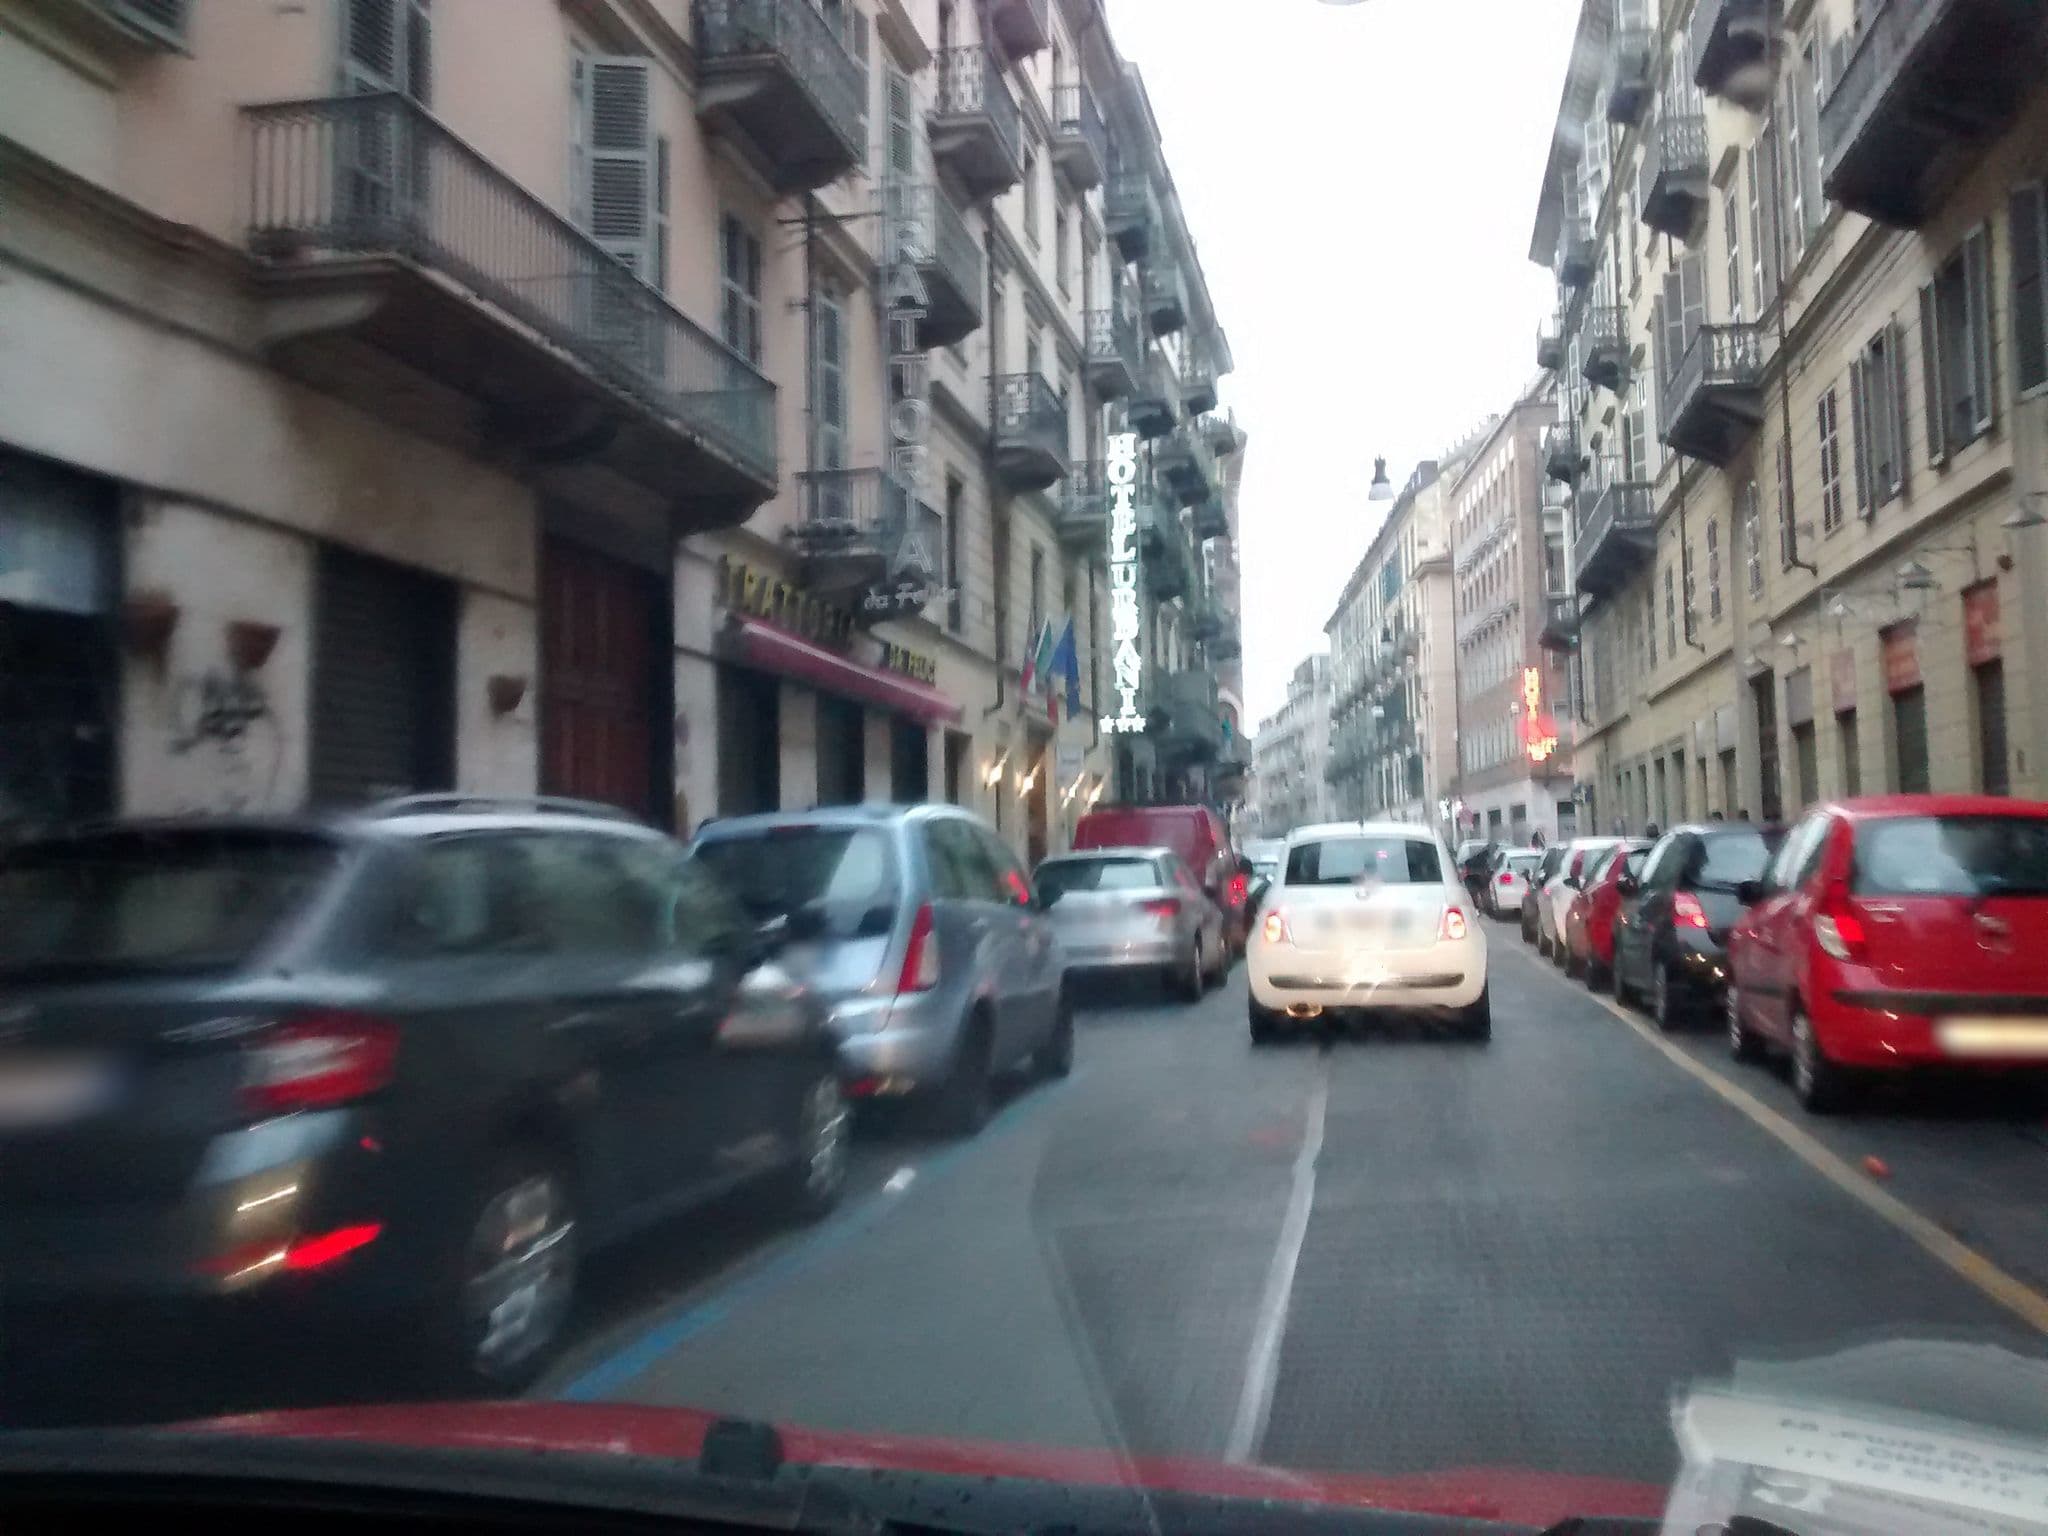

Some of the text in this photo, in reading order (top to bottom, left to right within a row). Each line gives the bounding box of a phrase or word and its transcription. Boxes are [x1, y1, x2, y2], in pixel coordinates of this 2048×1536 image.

[887, 184, 932, 573] TRATTORIA
[1107, 432, 1137, 562] HOTEL
[1110, 563, 1142, 715] URBANI
